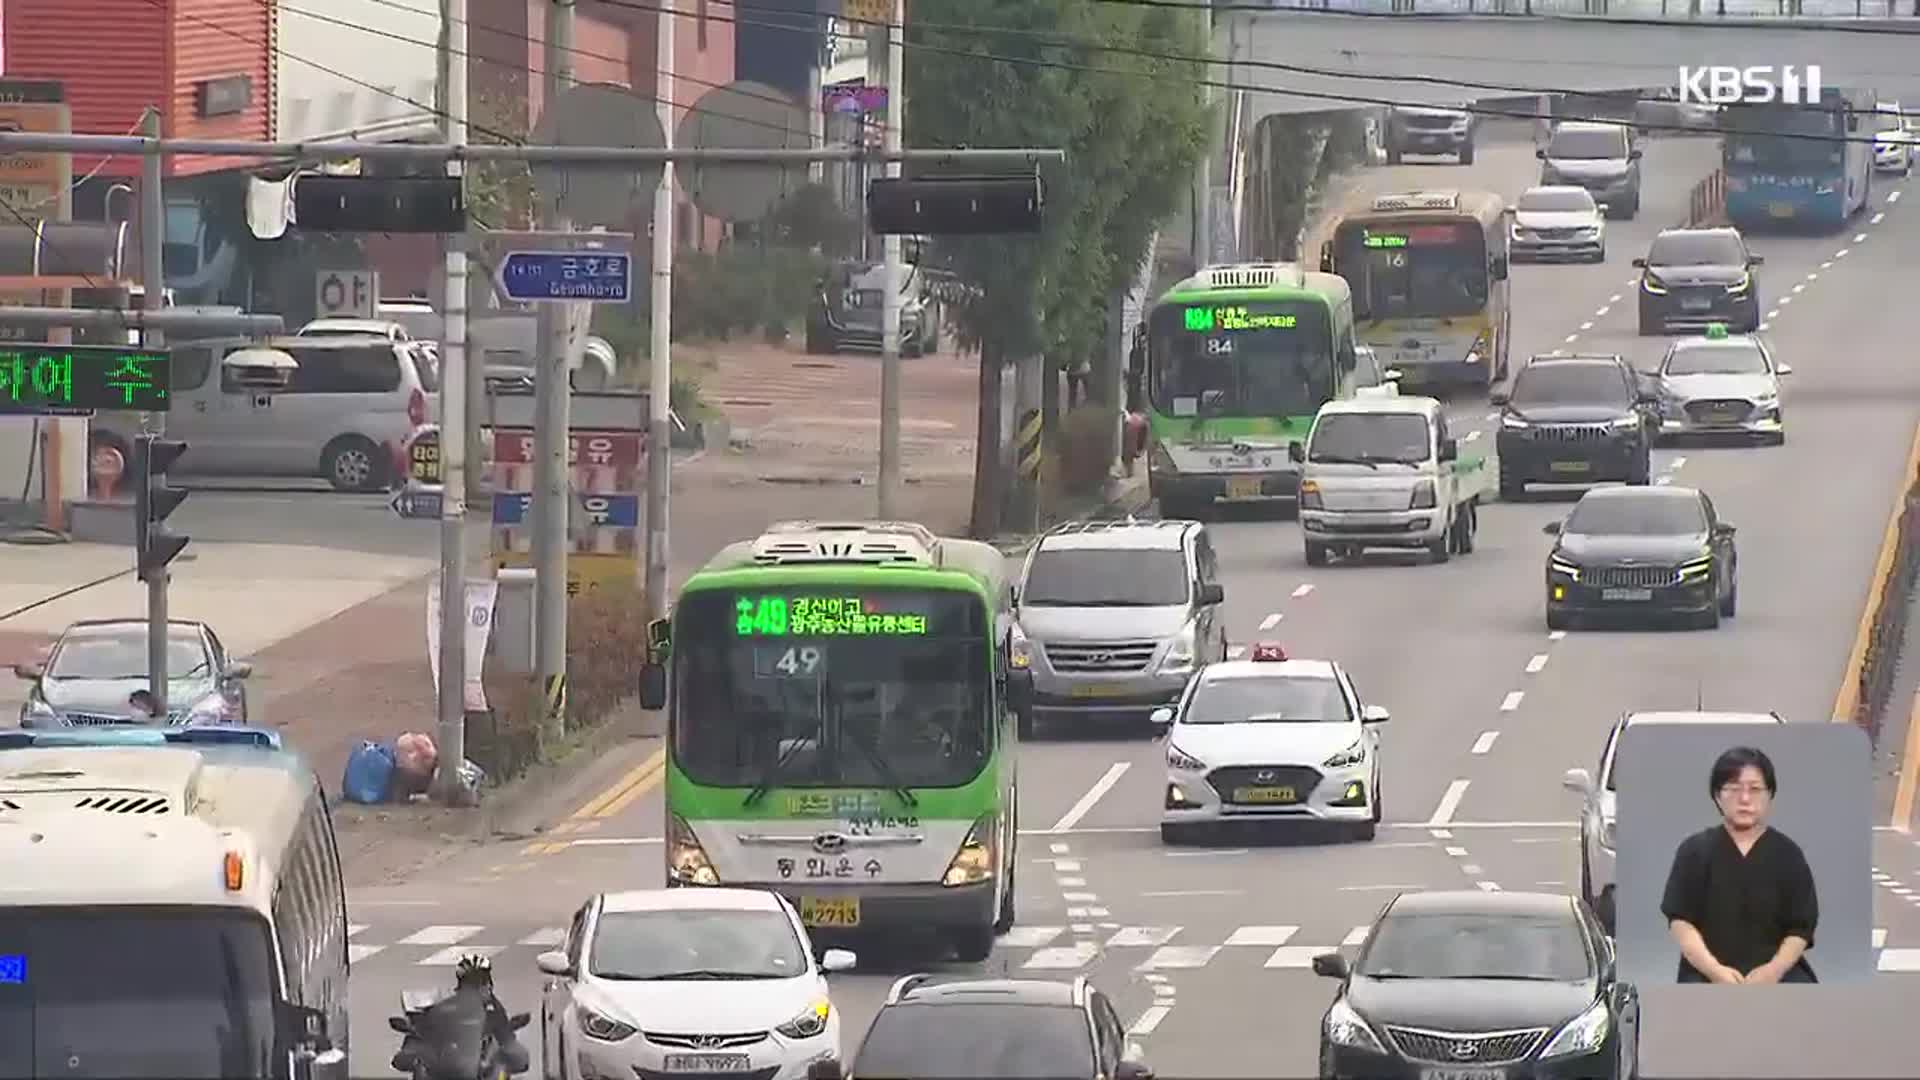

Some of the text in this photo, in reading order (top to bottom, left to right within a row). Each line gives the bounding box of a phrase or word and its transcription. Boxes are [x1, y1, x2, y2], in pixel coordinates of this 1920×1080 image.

[561, 258, 623, 279] 금호로
[1386, 254, 1404, 268] 16
[1208, 339, 1232, 353] 84
[776, 647, 820, 674] 49
